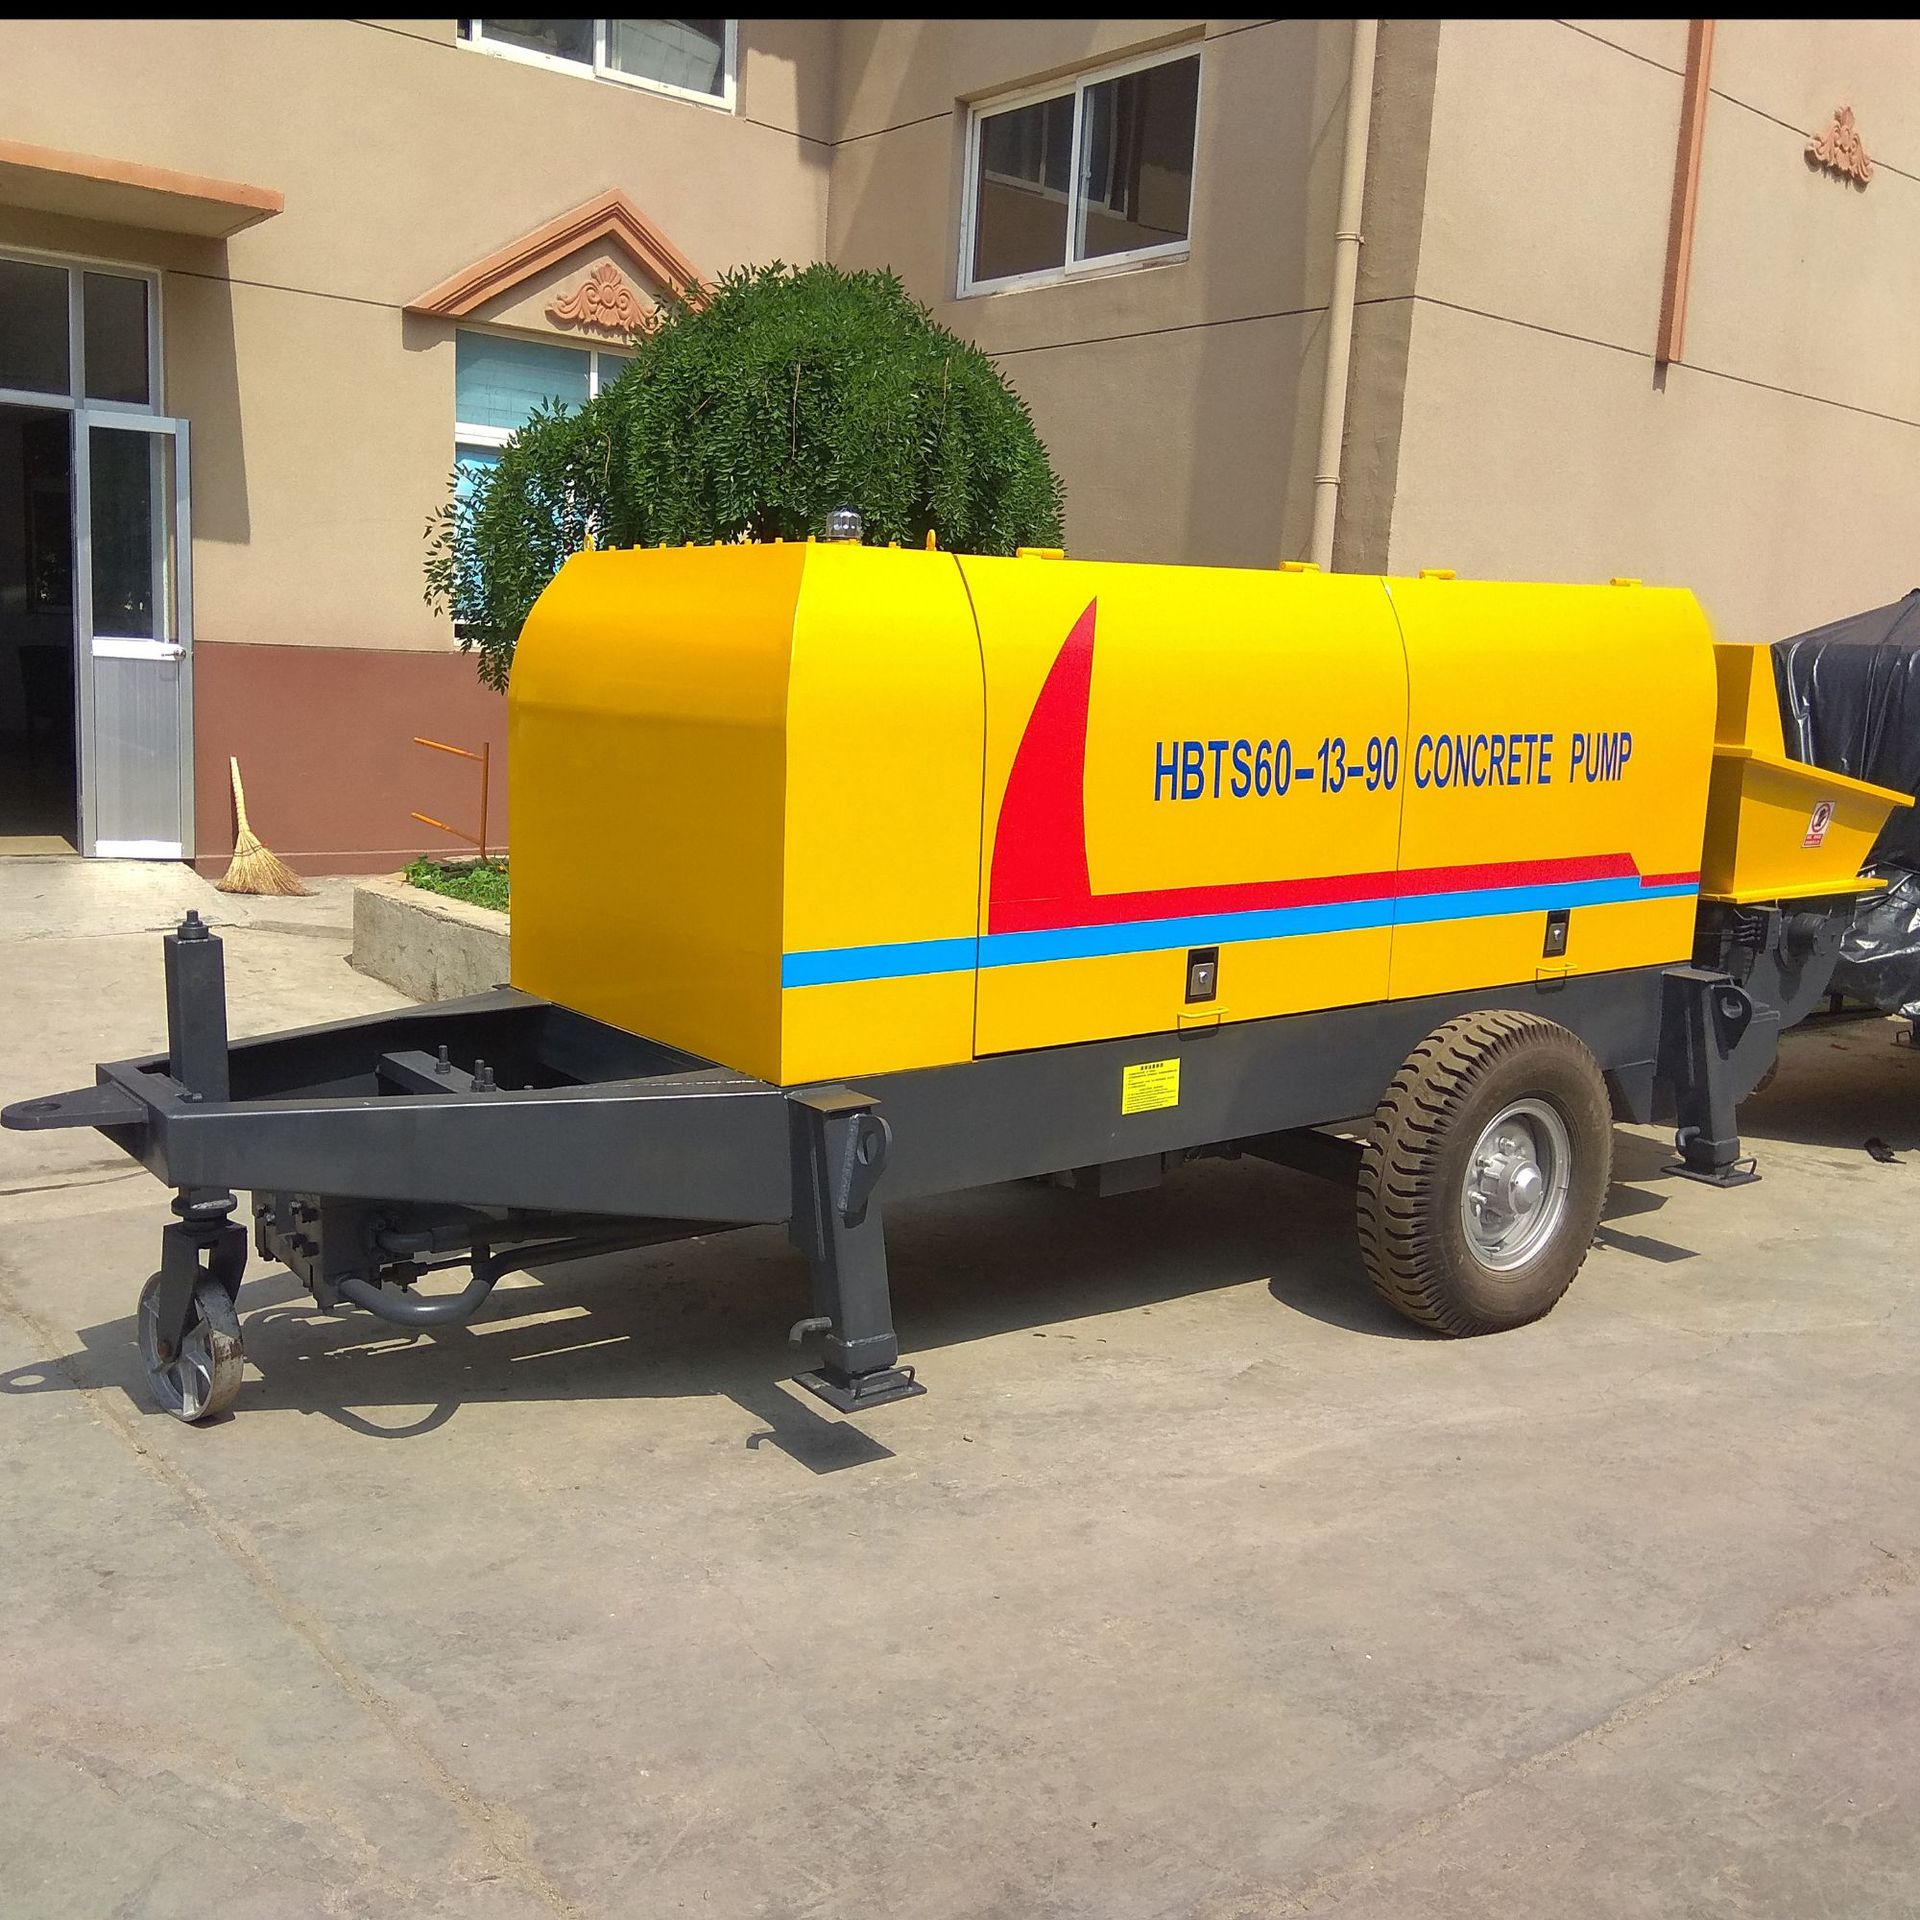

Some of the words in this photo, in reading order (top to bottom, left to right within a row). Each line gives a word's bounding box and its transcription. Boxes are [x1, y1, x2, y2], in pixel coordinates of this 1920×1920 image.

[1154, 736, 1398, 801] HBTS60-13-90
[1415, 734, 1554, 788] CONCRETE
[1570, 732, 1632, 783] PUMP
